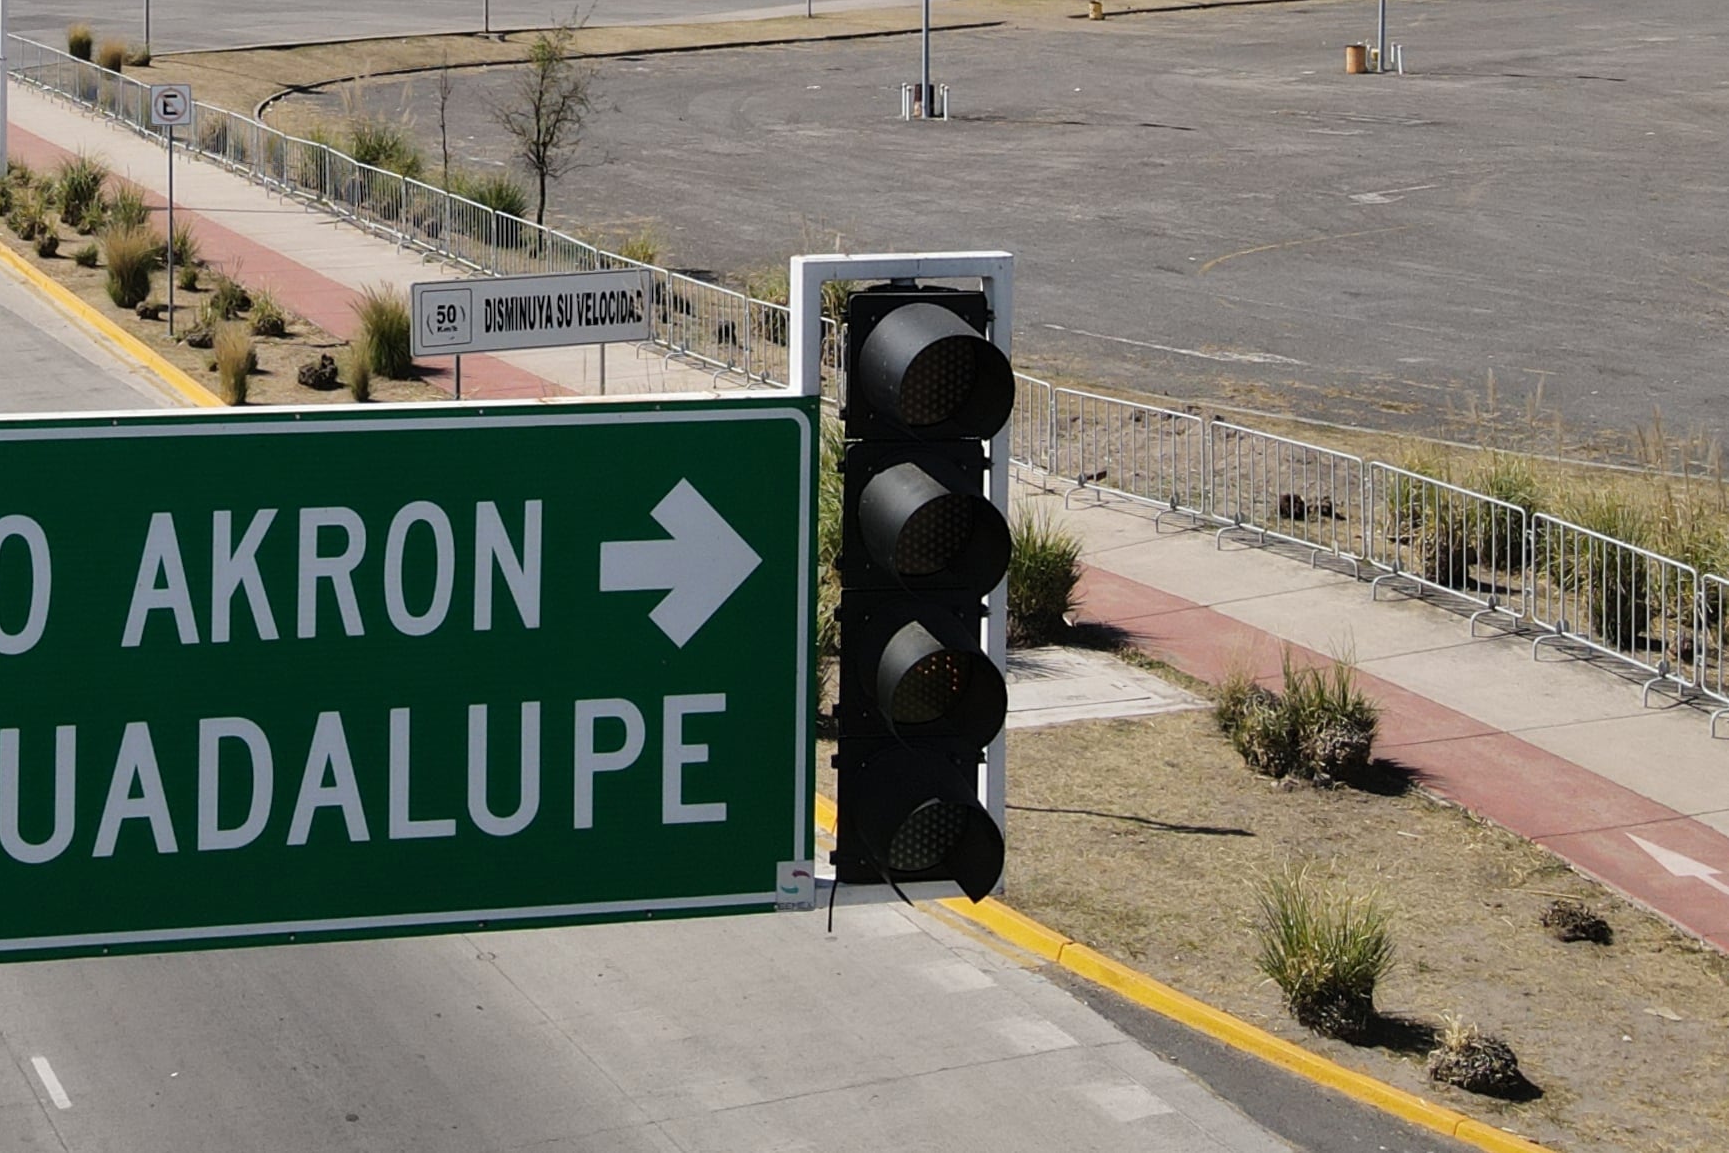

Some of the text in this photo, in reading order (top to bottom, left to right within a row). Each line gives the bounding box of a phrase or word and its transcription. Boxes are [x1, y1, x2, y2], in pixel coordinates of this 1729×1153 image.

[163, 94, 178, 115] E
[437, 304, 456, 324] 50
[484, 290, 643, 333] DISMINUYA SU VELOCIDAD
[121, 499, 543, 647] AKRON
